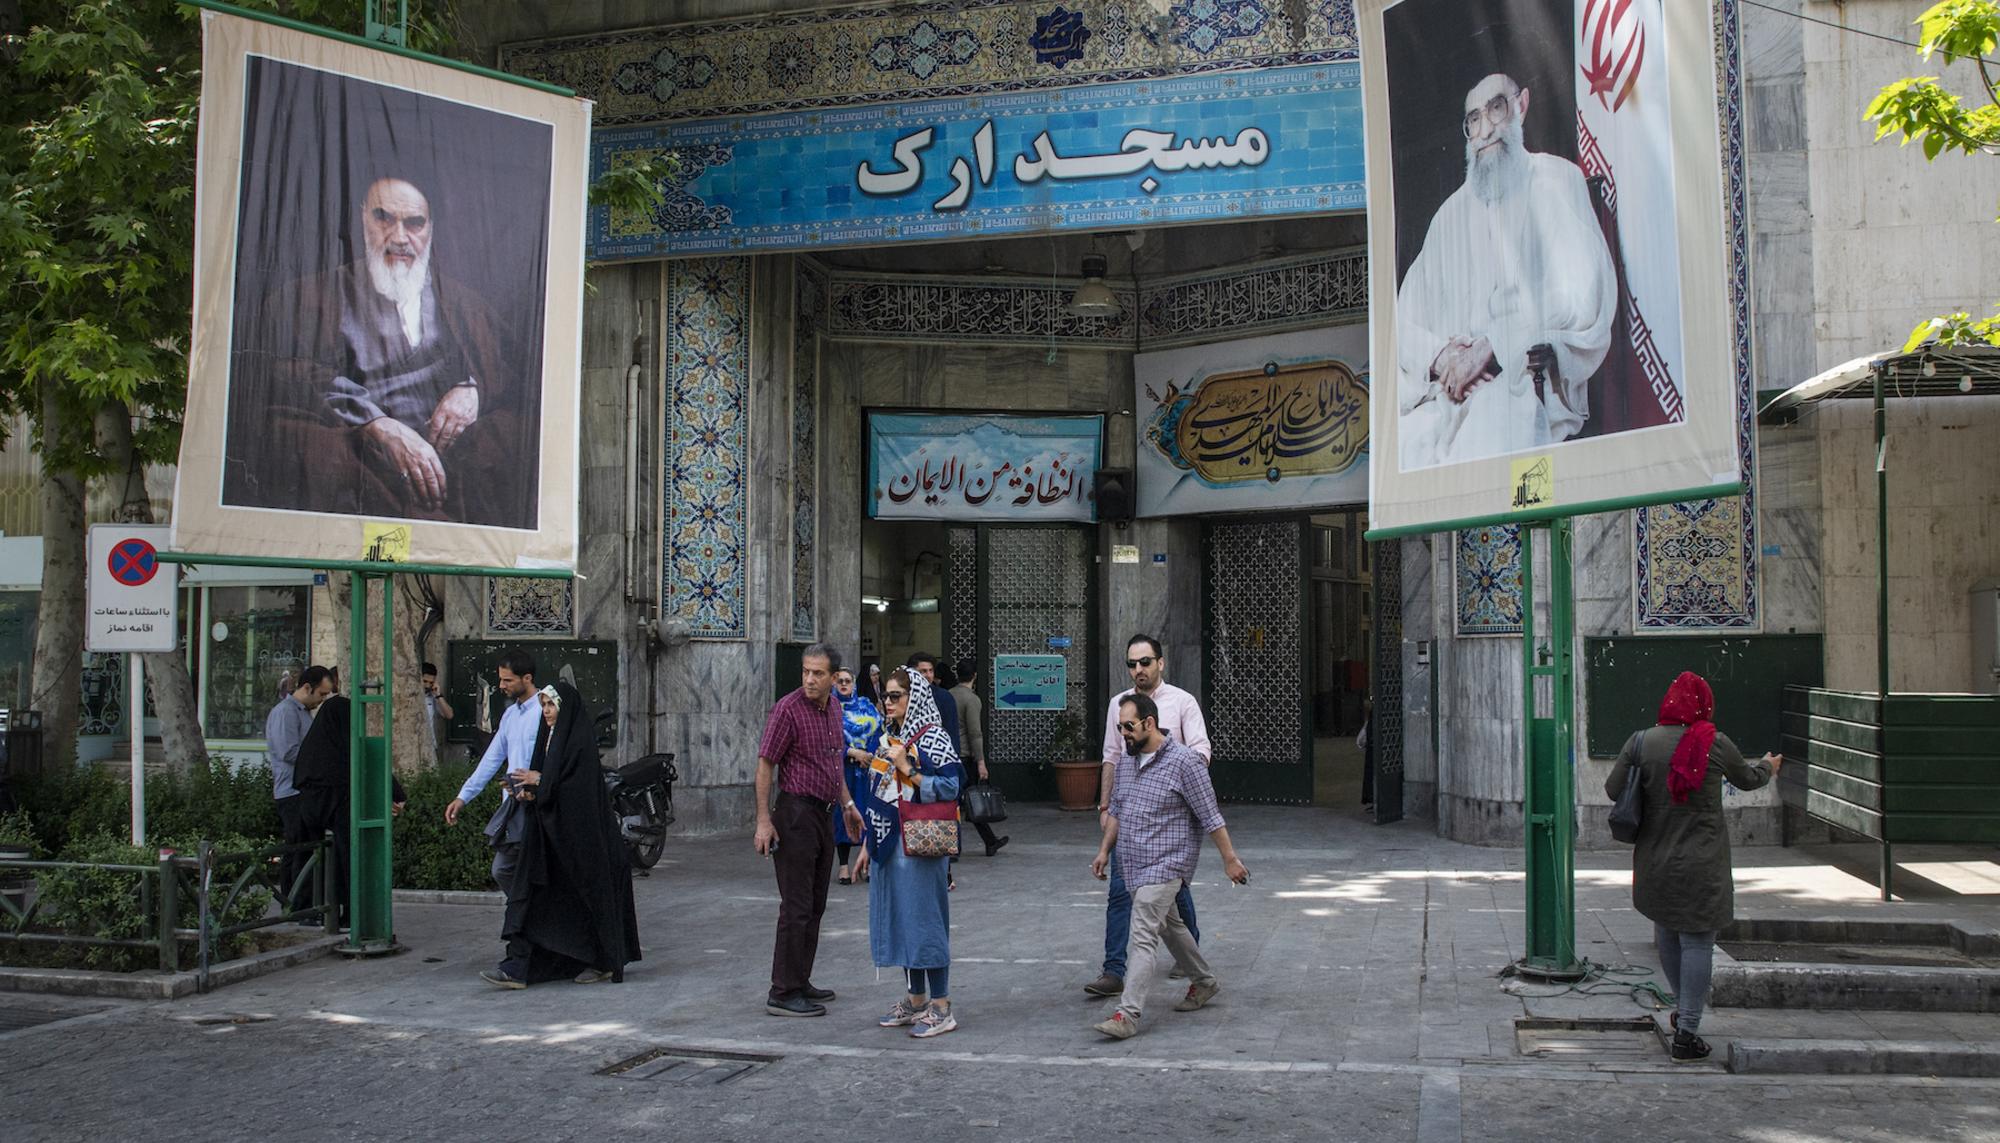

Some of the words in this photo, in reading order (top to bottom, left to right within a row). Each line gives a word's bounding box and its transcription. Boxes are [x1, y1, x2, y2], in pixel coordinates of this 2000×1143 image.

[1013, 125, 1270, 193] مسجد
[857, 119, 996, 210] ارک
[94, 607, 128, 615] ساعات
[106, 624, 127, 634] نماز
[129, 624, 153, 632] اقامه
